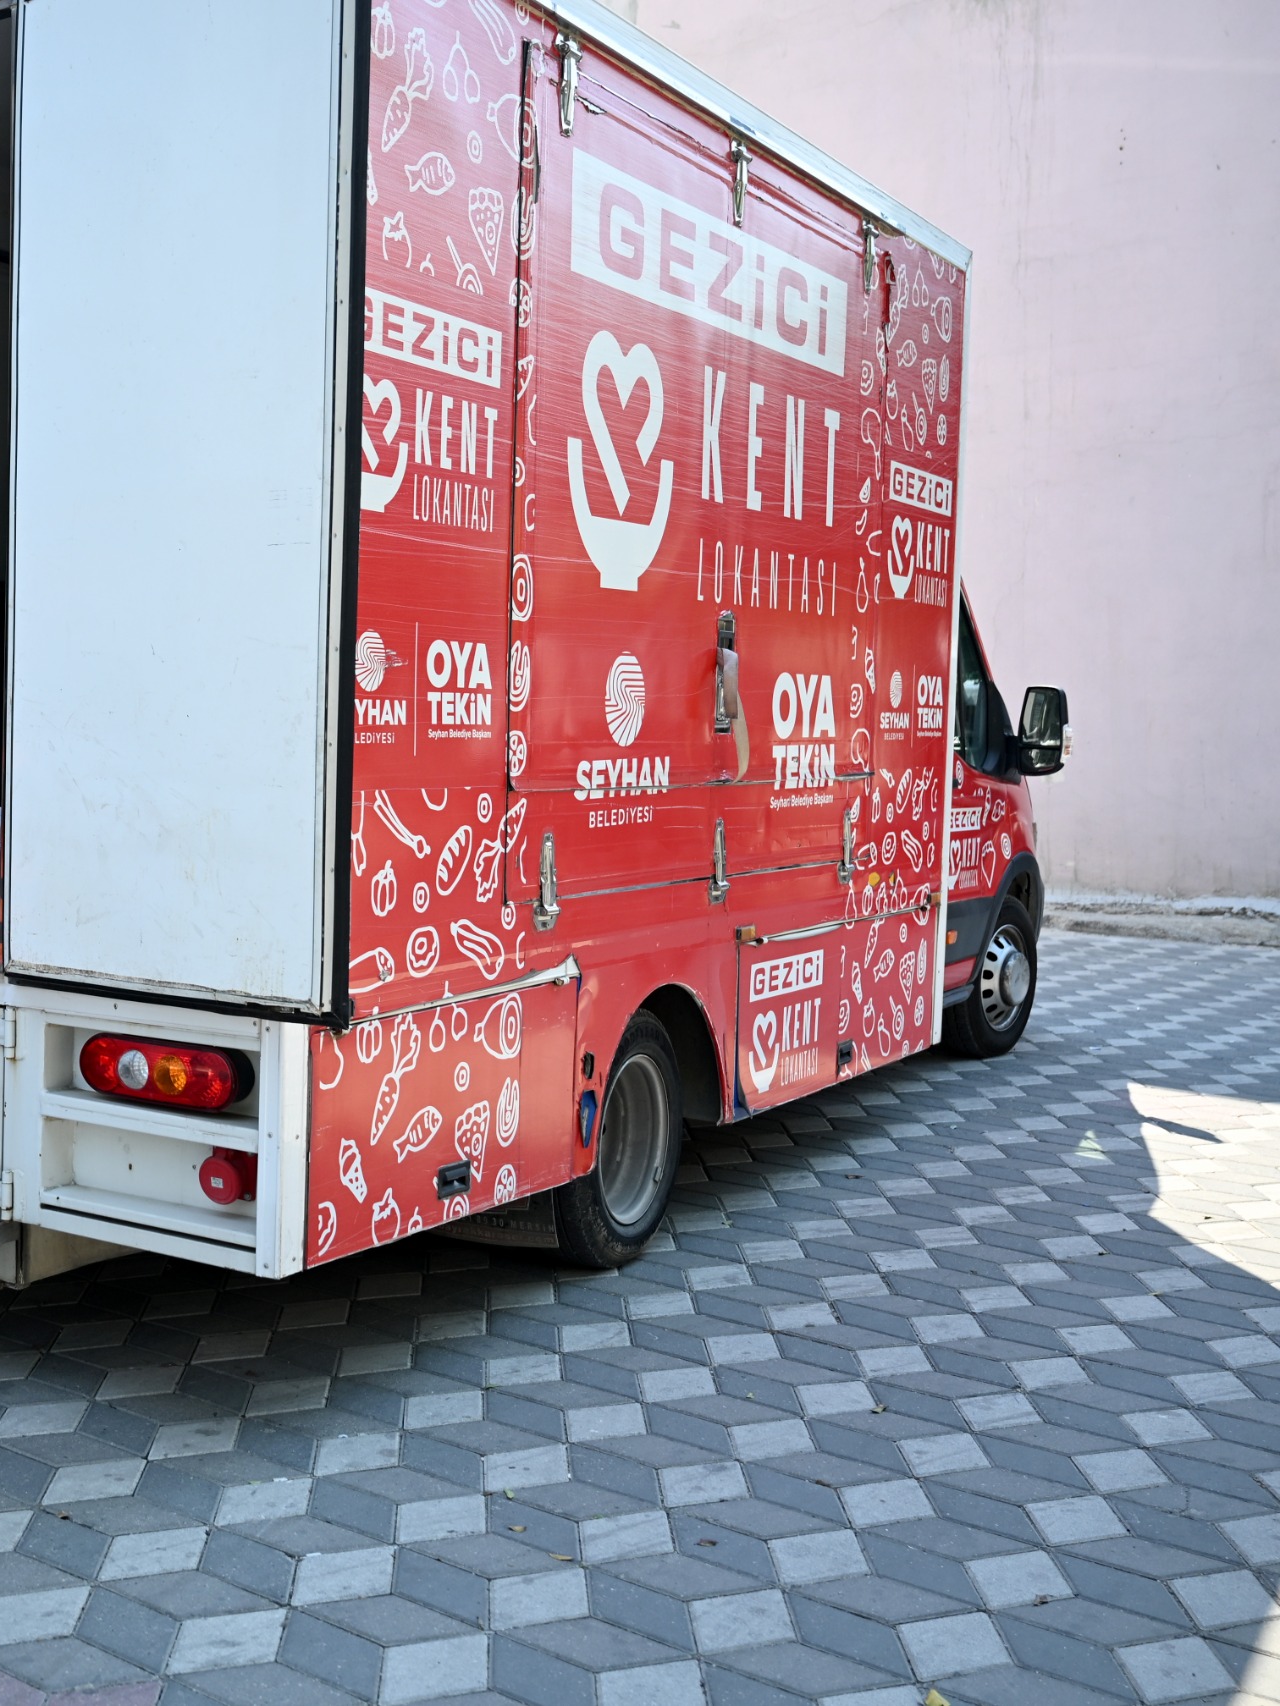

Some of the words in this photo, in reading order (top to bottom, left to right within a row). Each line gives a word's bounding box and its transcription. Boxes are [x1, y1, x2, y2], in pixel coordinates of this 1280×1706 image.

[414, 388, 498, 479] KENT
[702, 365, 841, 527] KENT
[412, 473, 495, 533] LOKANTASI
[916, 521, 951, 574] KENT
[697, 537, 837, 617] LOKANTASI
[426, 639, 493, 690] OYA
[917, 675, 944, 706] OYA
[772, 671, 836, 740] OYA
[880, 712, 910, 729] SEYHAN
[428, 728, 448, 741] Seyhan
[449, 728, 472, 740] Belediye
[573, 756, 670, 801] SEYHAN
[782, 997, 821, 1052] KENT
[780, 1047, 818, 1086] LOKANTASI
